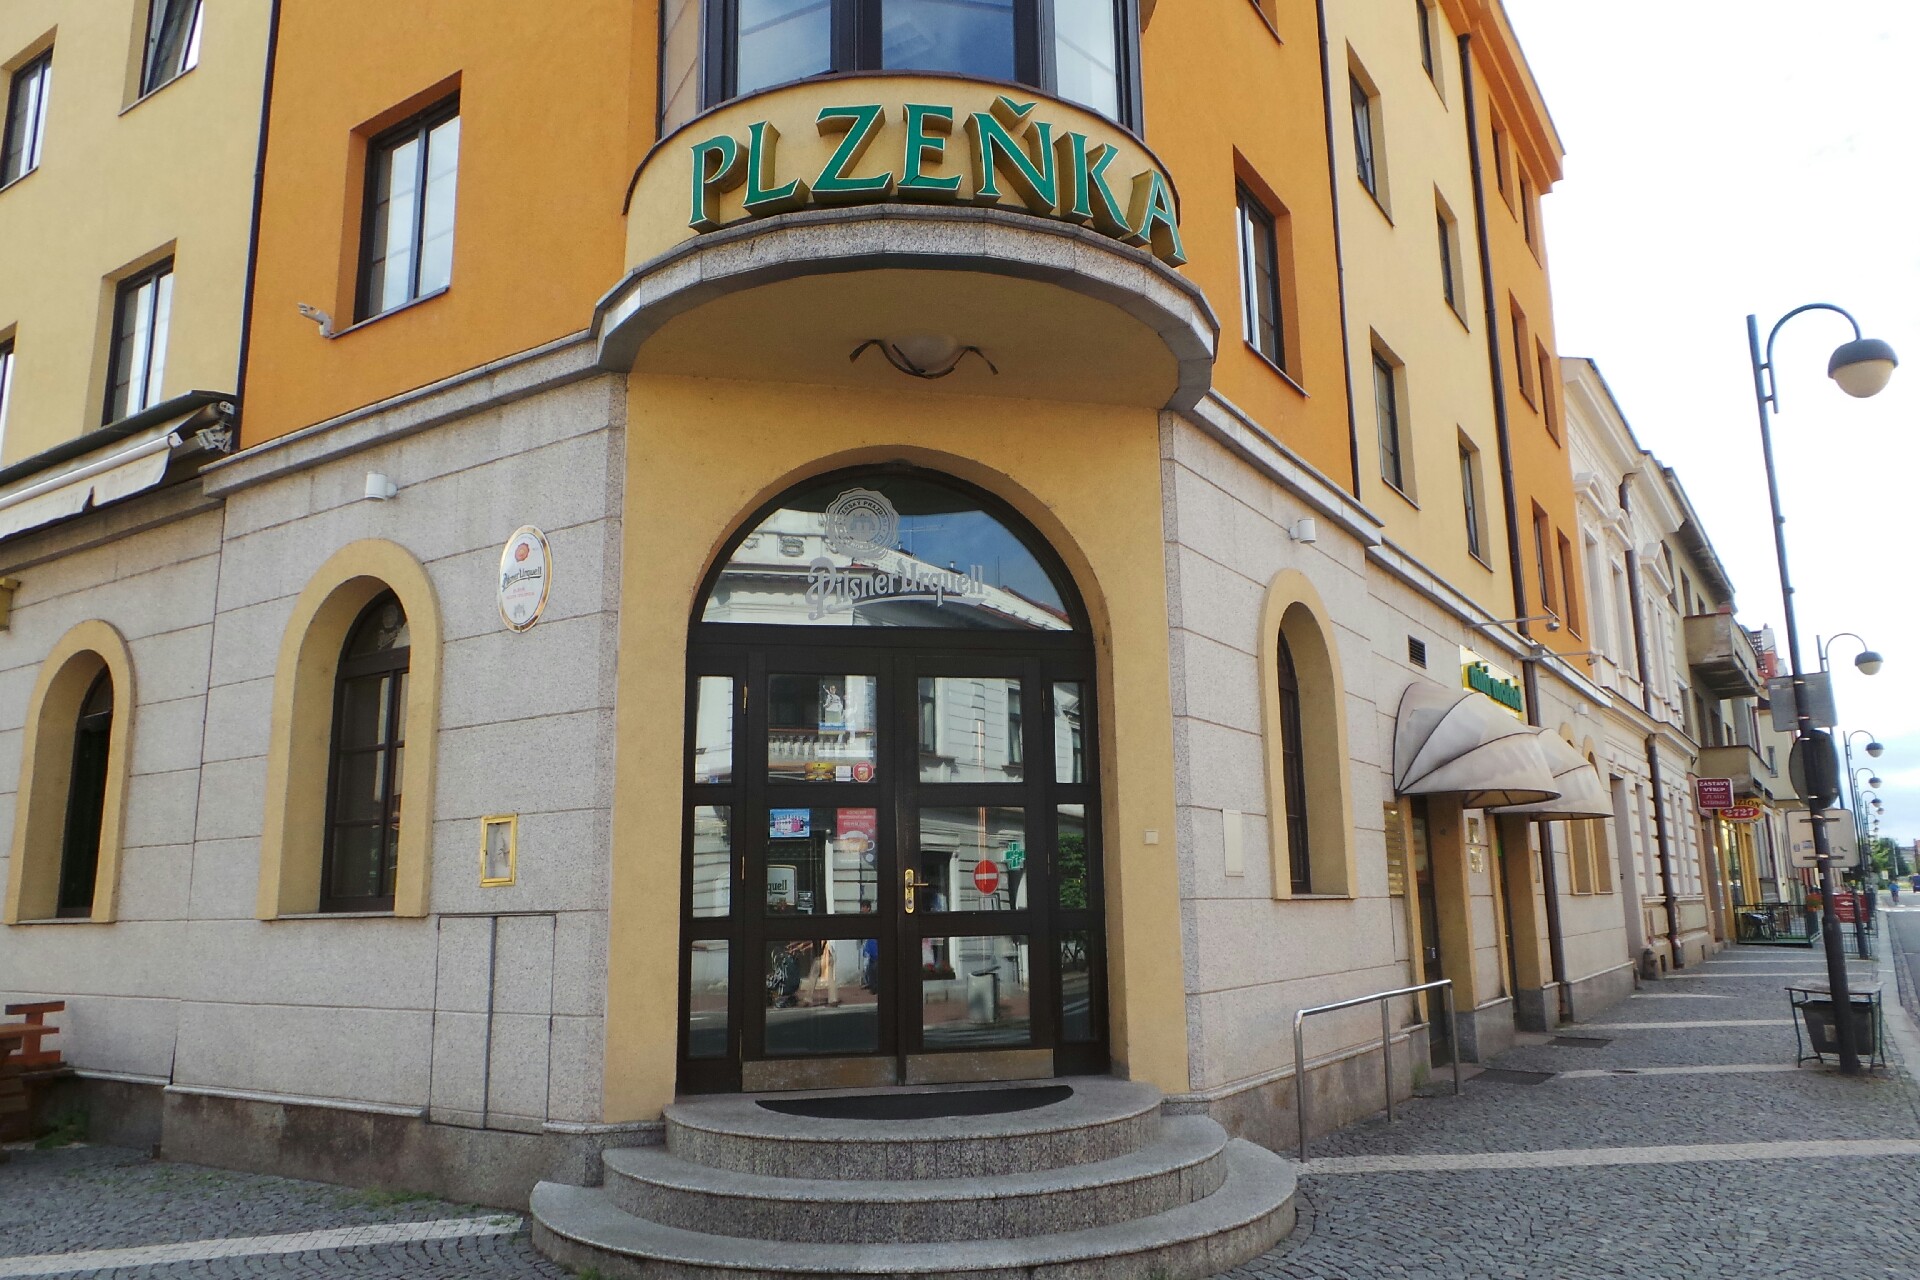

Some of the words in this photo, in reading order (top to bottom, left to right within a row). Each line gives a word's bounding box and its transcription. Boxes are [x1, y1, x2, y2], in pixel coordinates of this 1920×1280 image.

[688, 95, 1188, 267] PLZEŇKA
[805, 556, 900, 620] Pilsner
[897, 558, 984, 608] Urquell
